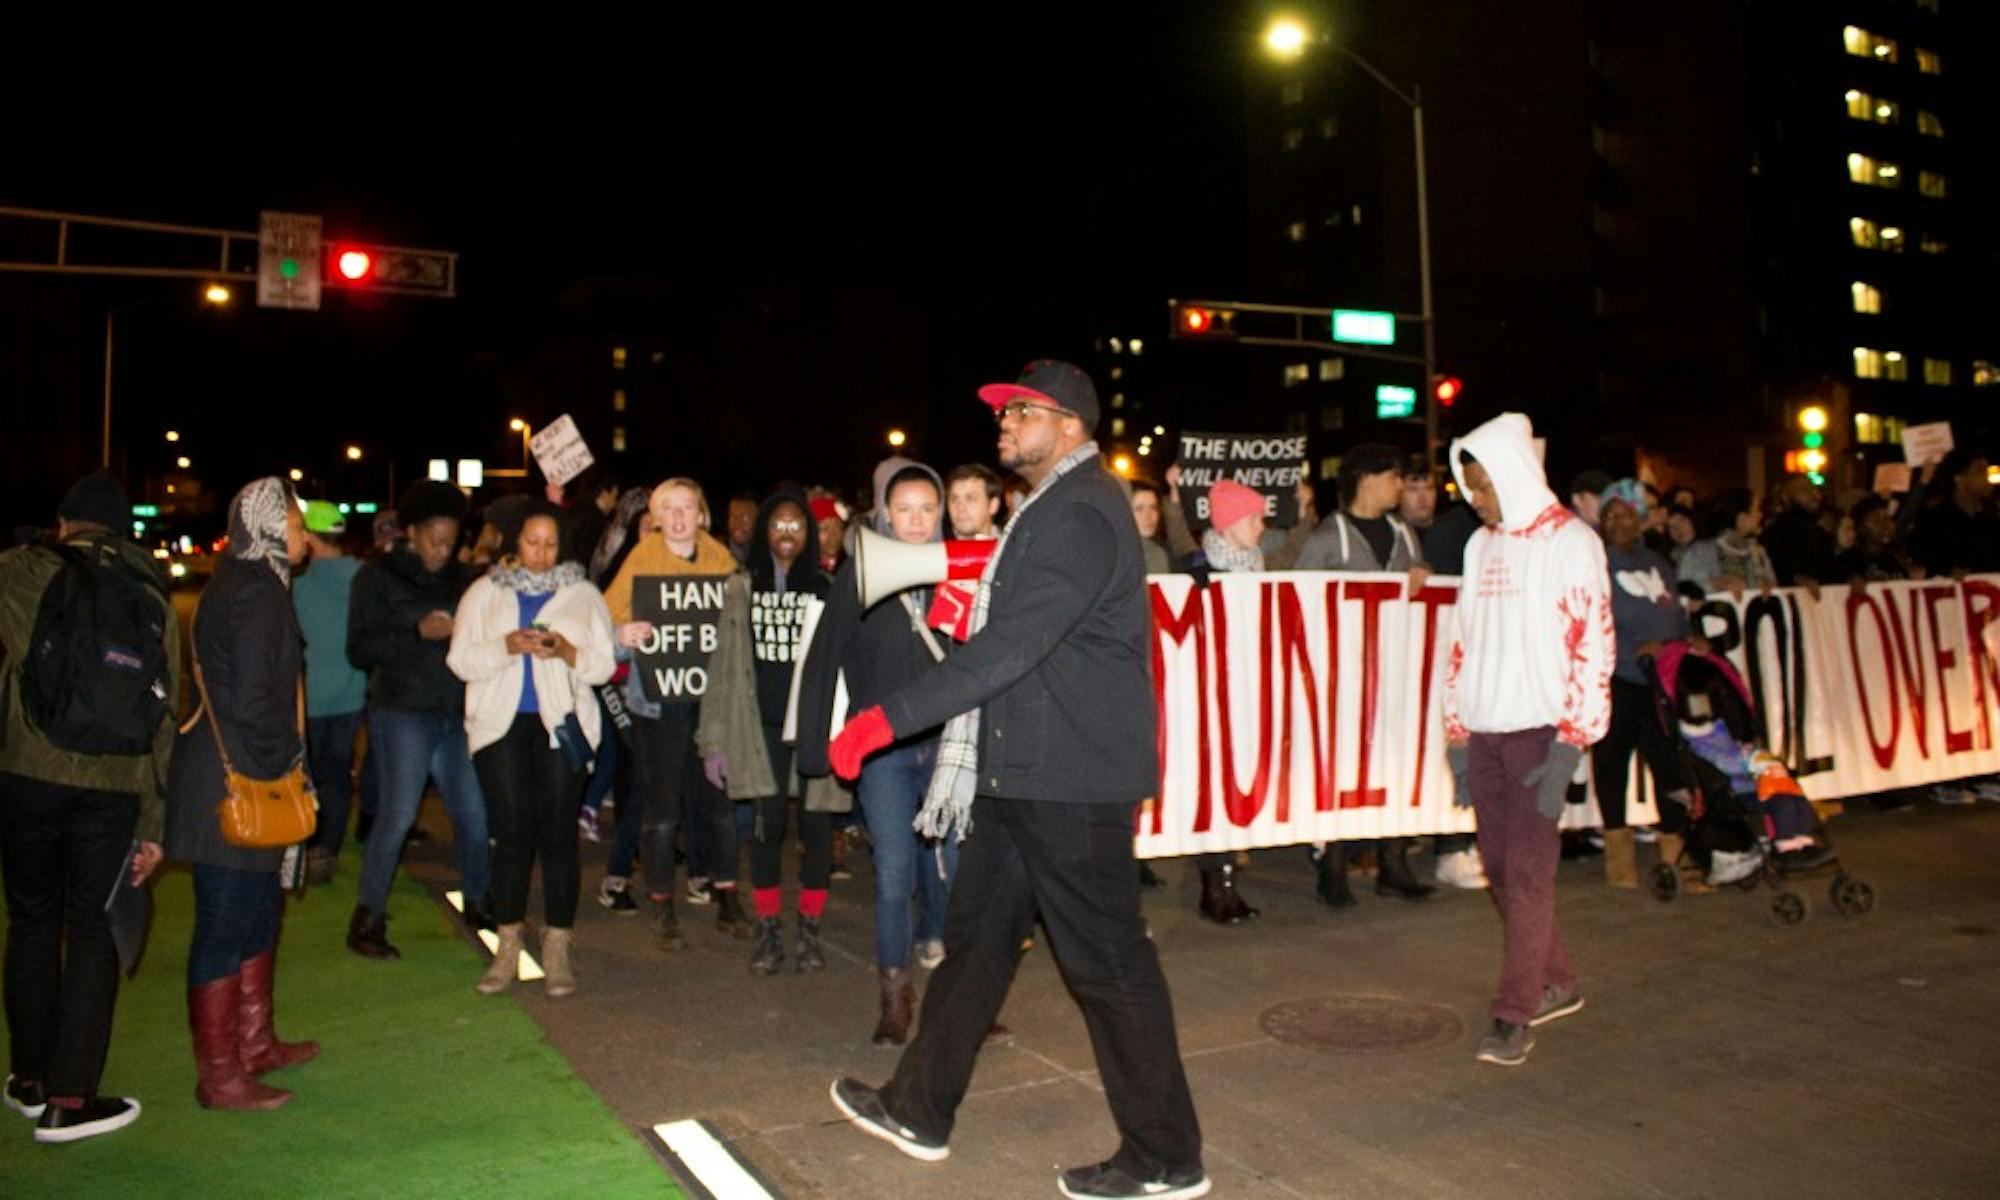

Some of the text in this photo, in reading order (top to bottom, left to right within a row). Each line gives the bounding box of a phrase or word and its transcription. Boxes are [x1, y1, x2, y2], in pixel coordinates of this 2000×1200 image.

[1181, 436, 1307, 460] THE NOOSE
[1177, 466, 1302, 487] WILL NEVER
[660, 580, 728, 611] HAN
[751, 606, 806, 626] RESPE
[639, 623, 719, 655] OFF B
[753, 624, 801, 642] TABL
[655, 667, 709, 697] WO
[1134, 578, 1459, 834] MUNIT
[1846, 580, 2000, 770] OVER
